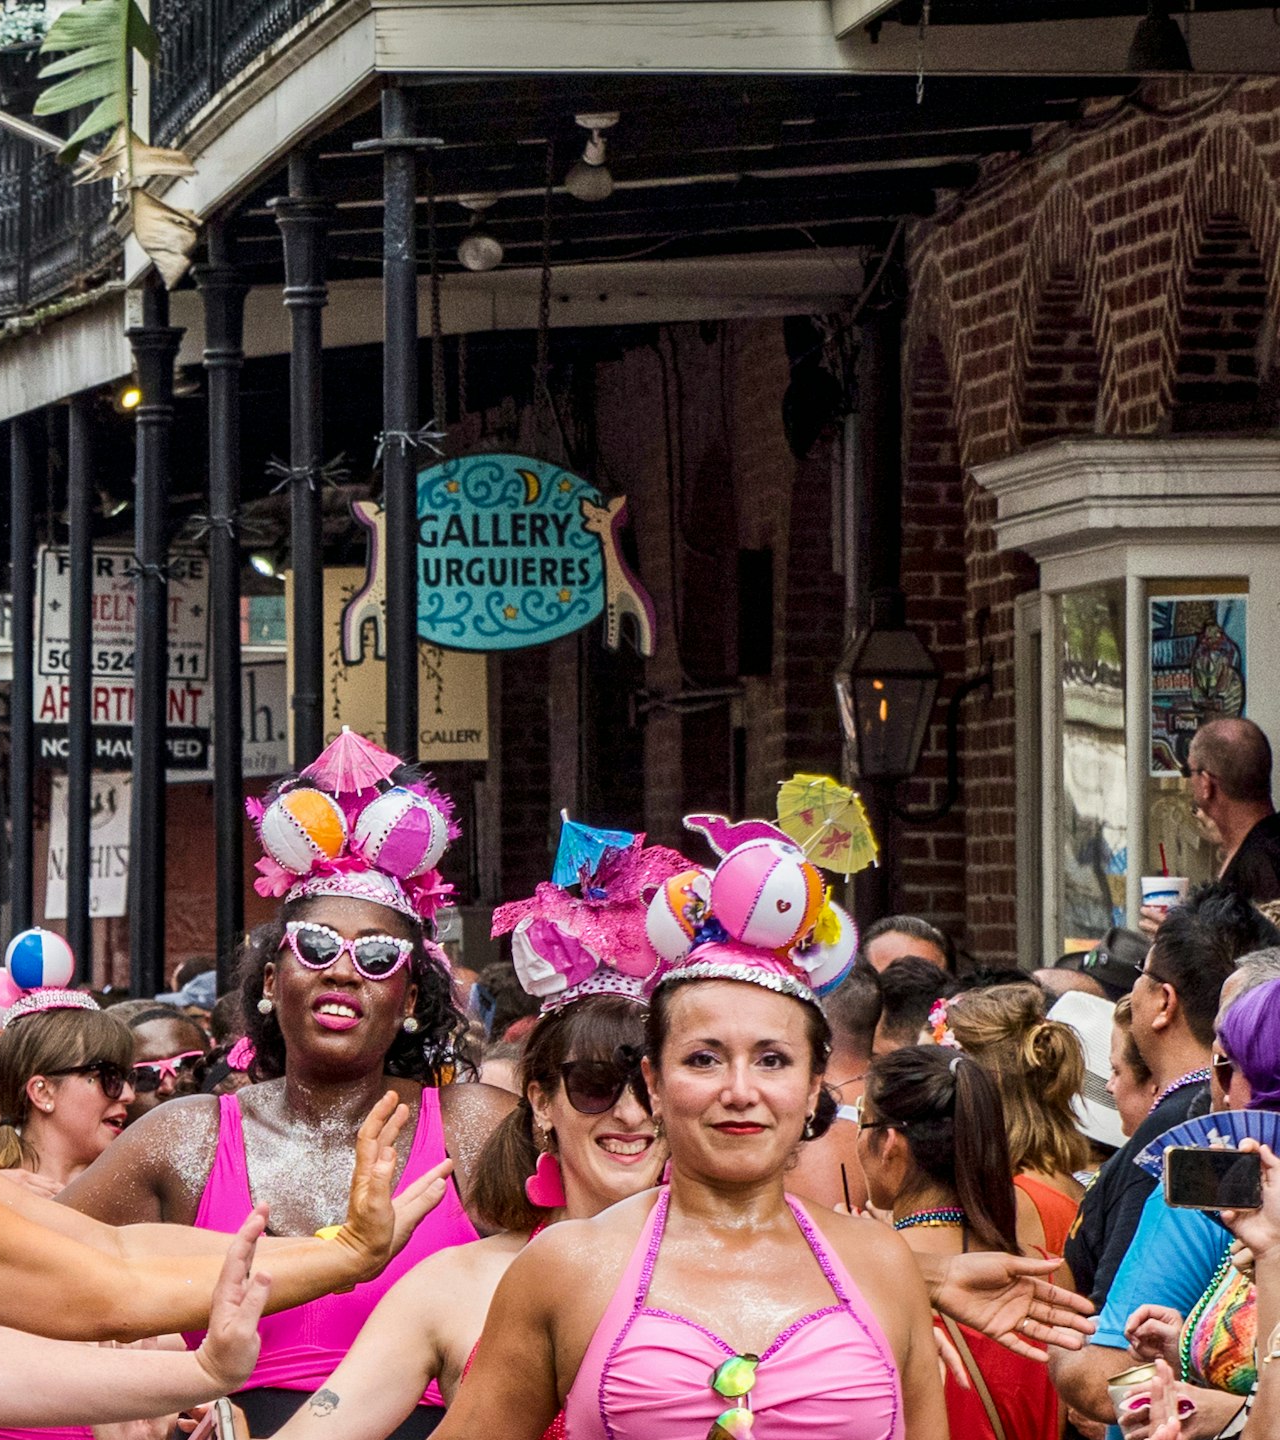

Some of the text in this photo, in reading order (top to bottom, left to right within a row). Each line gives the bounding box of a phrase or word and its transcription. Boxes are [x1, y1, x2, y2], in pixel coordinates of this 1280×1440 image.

[417, 513, 573, 548] GALLERY
[418, 557, 591, 588] URGUIERES
[420, 729, 482, 744] GALLERY
